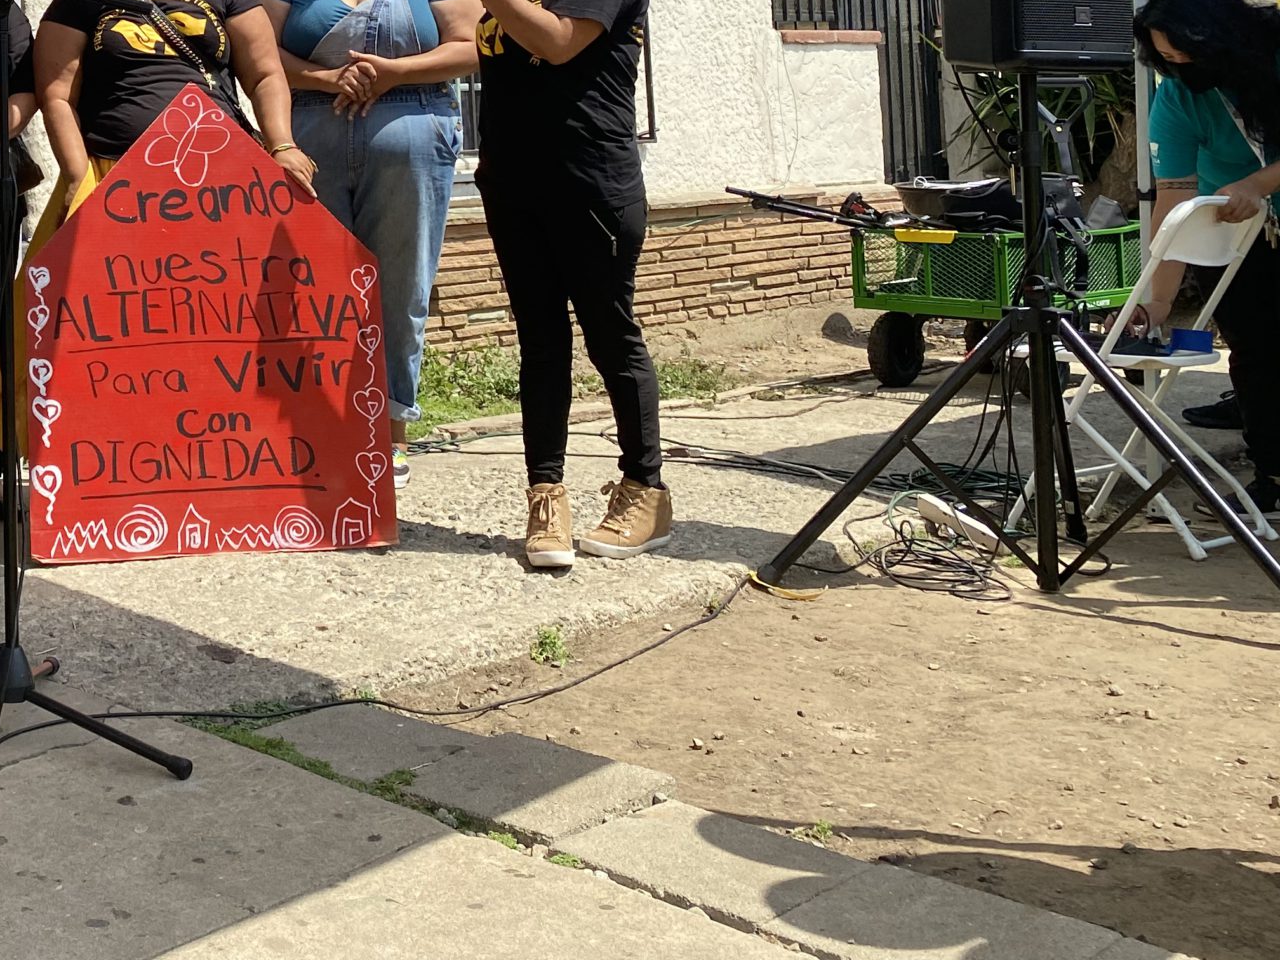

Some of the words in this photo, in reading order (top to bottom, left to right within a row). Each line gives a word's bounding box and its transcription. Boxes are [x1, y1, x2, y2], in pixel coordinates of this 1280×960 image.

[104, 167, 294, 224] Creando
[105, 237, 317, 291] nuestra
[54, 286, 365, 342] ALTERNATIVA
[86, 360, 189, 399] Para
